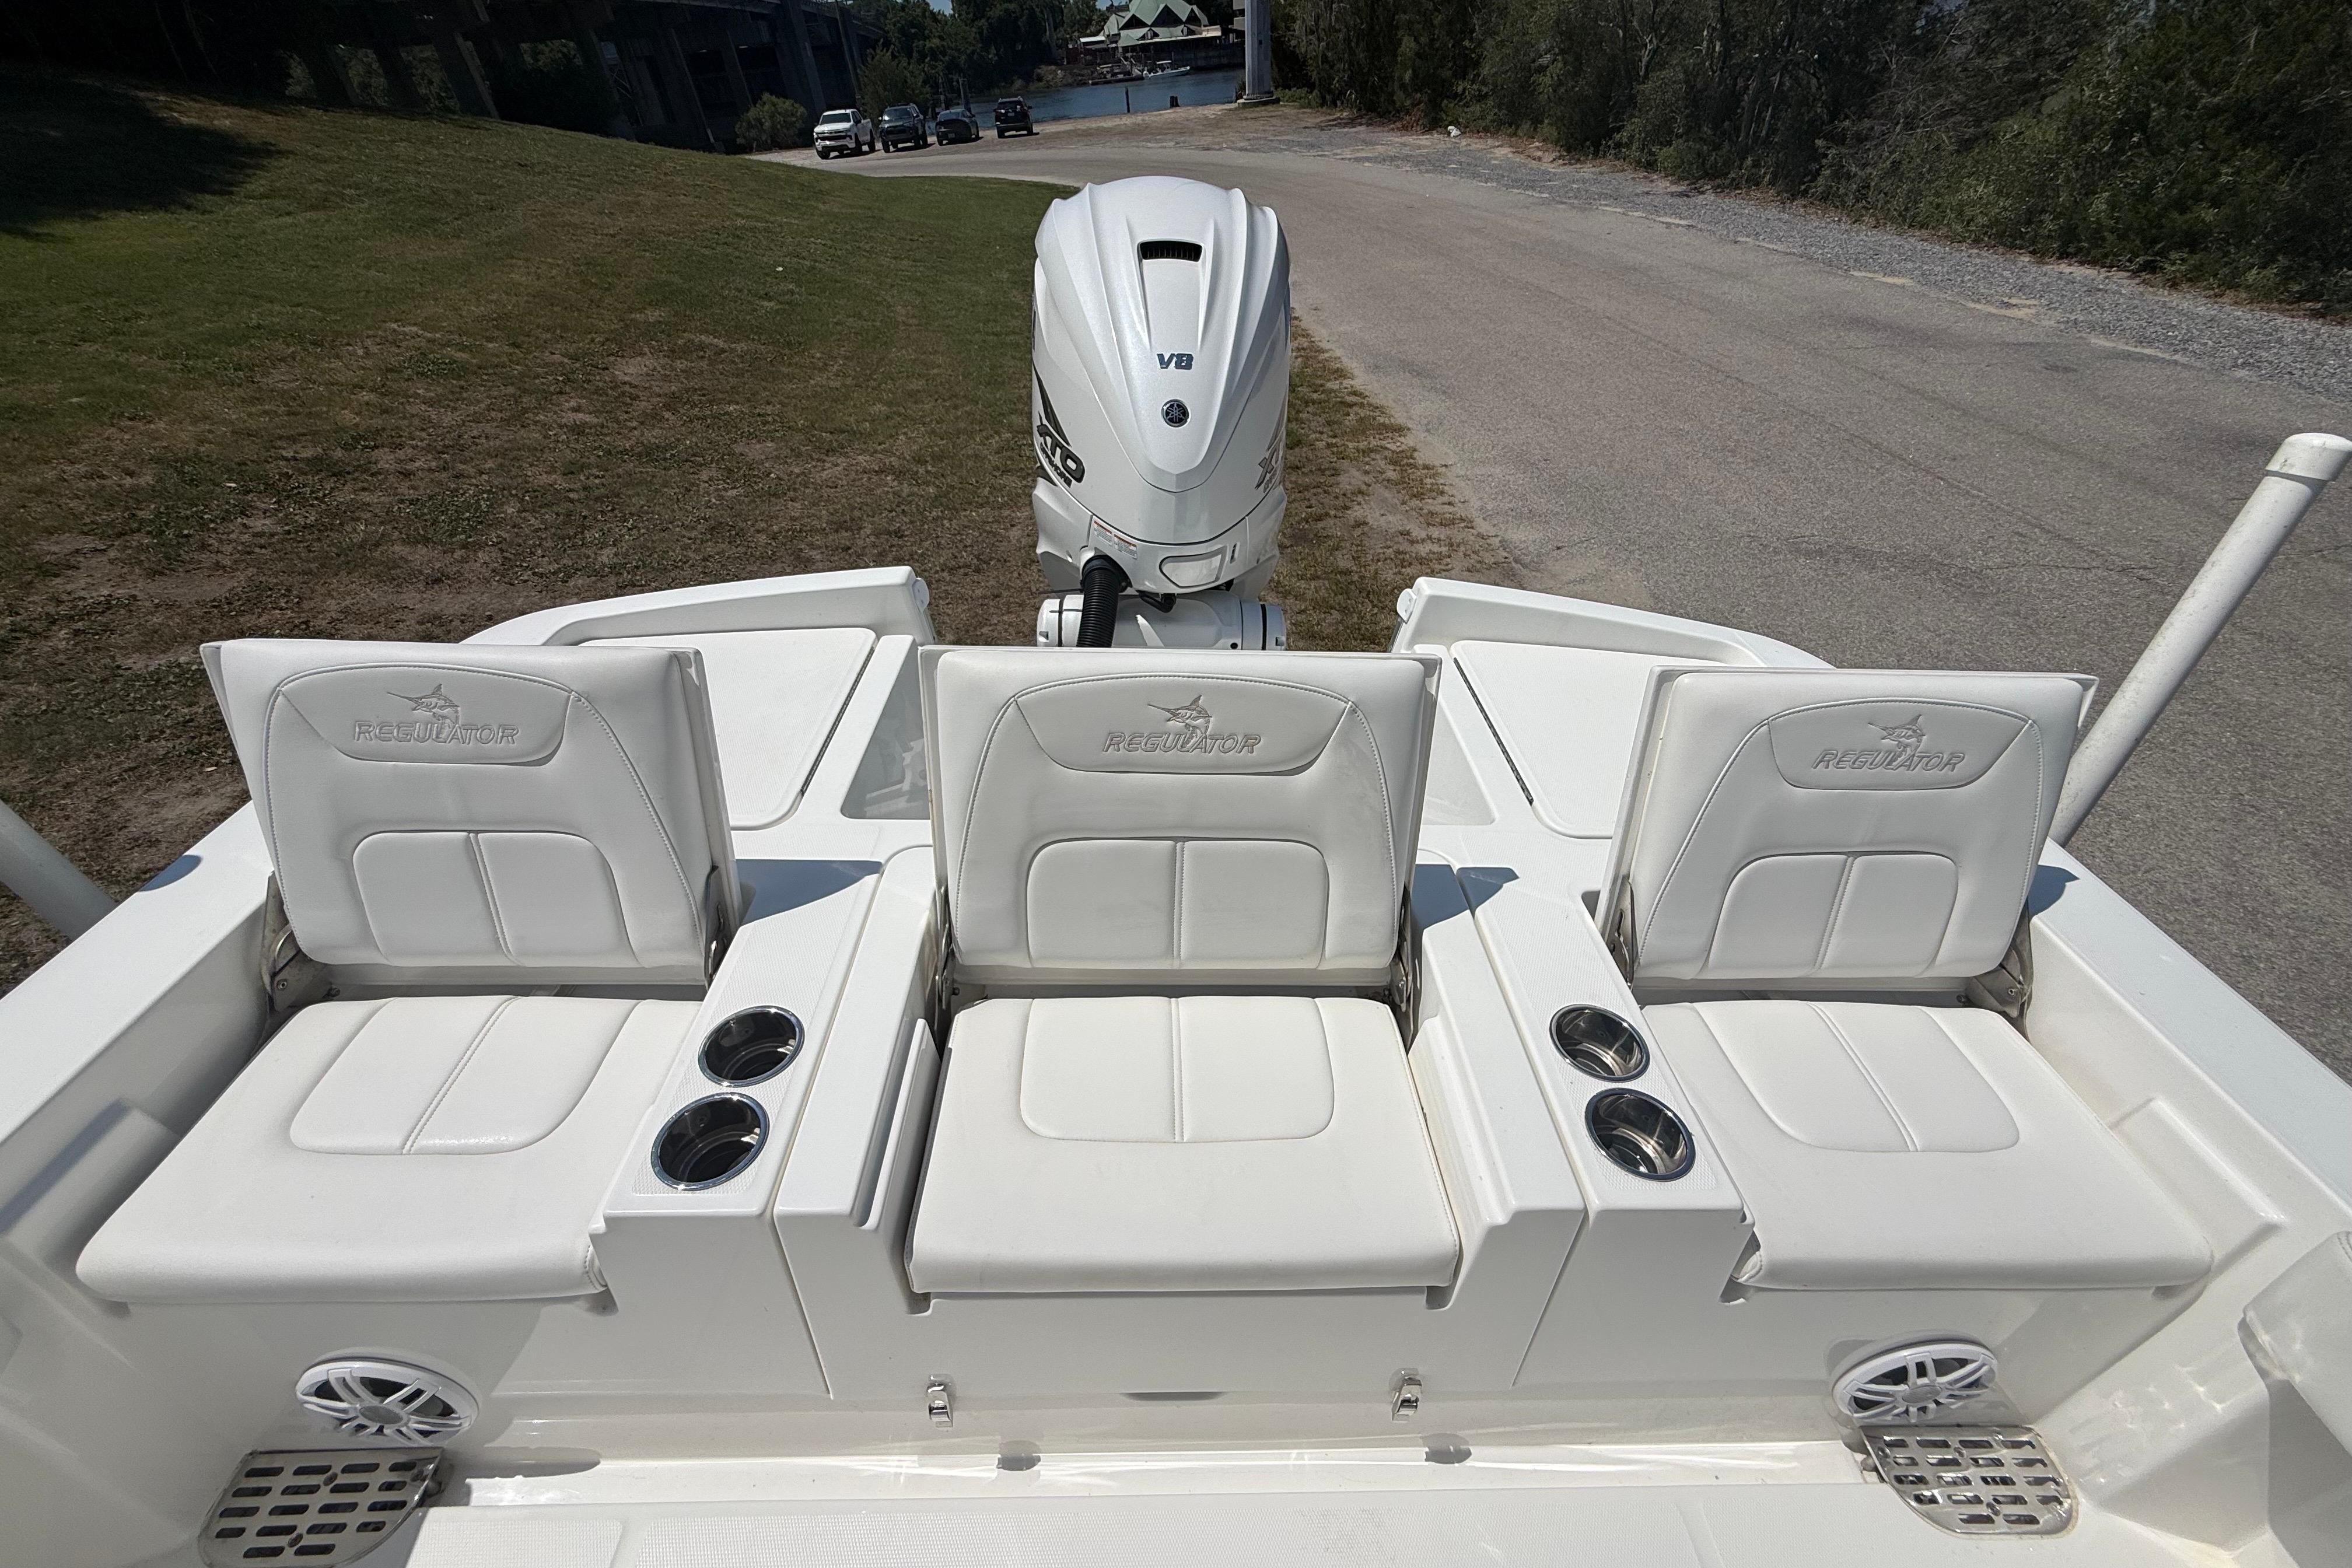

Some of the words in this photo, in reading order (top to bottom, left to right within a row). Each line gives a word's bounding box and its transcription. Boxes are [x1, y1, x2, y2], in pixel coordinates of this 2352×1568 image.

[1157, 353, 1194, 370] V8
[354, 721, 519, 745] REGULATOR
[1102, 733, 1261, 754] REGULATOR
[1811, 750, 1965, 772] REGULATOR
